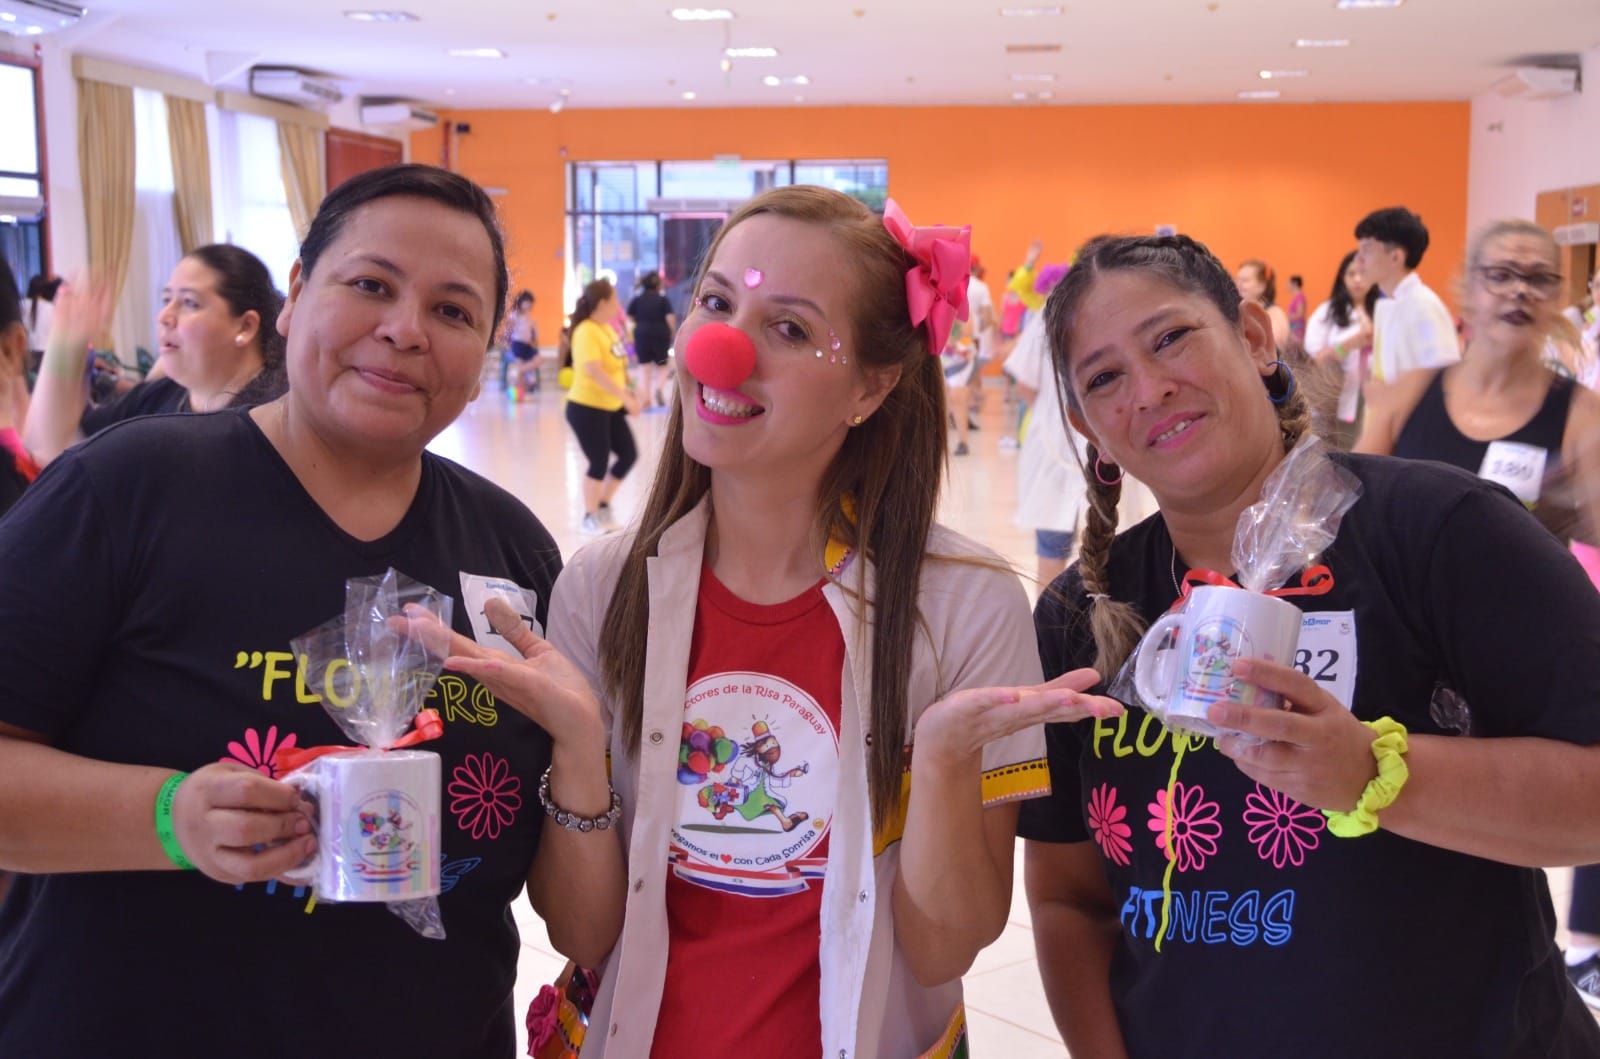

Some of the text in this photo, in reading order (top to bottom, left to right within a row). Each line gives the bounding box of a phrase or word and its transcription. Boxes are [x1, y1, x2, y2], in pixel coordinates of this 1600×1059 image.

[723, 684, 738, 694] de
[742, 684, 752, 694] la
[754, 685, 780, 701] Risa
[782, 694, 826, 734] Paraguay
[709, 852, 719, 860] el
[733, 857, 753, 865] con
[755, 853, 782, 865] Cada
[782, 829, 815, 858] Sonrisa
